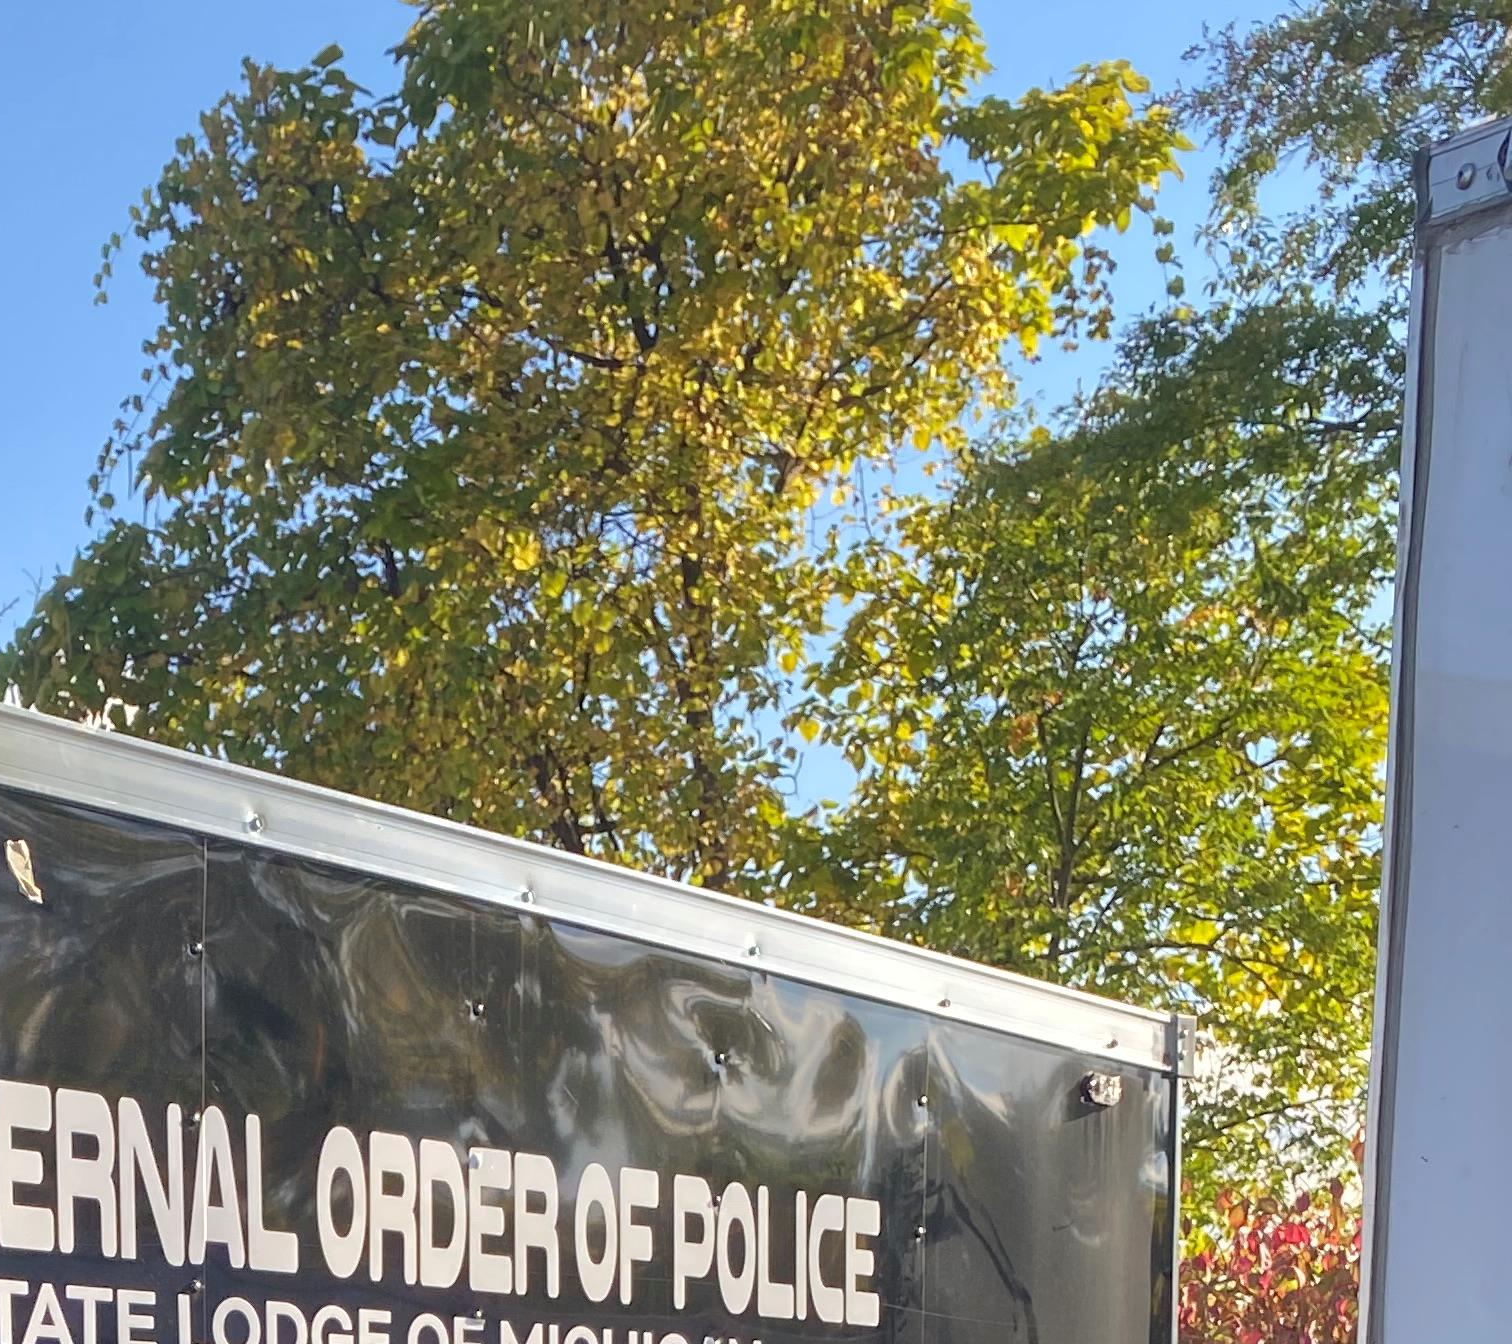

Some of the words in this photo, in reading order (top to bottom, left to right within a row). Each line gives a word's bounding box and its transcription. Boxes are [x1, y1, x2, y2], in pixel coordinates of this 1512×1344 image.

[317, 1125, 560, 1299] ORDER
[575, 1162, 660, 1305] OF
[674, 1173, 881, 1327] POLICE
